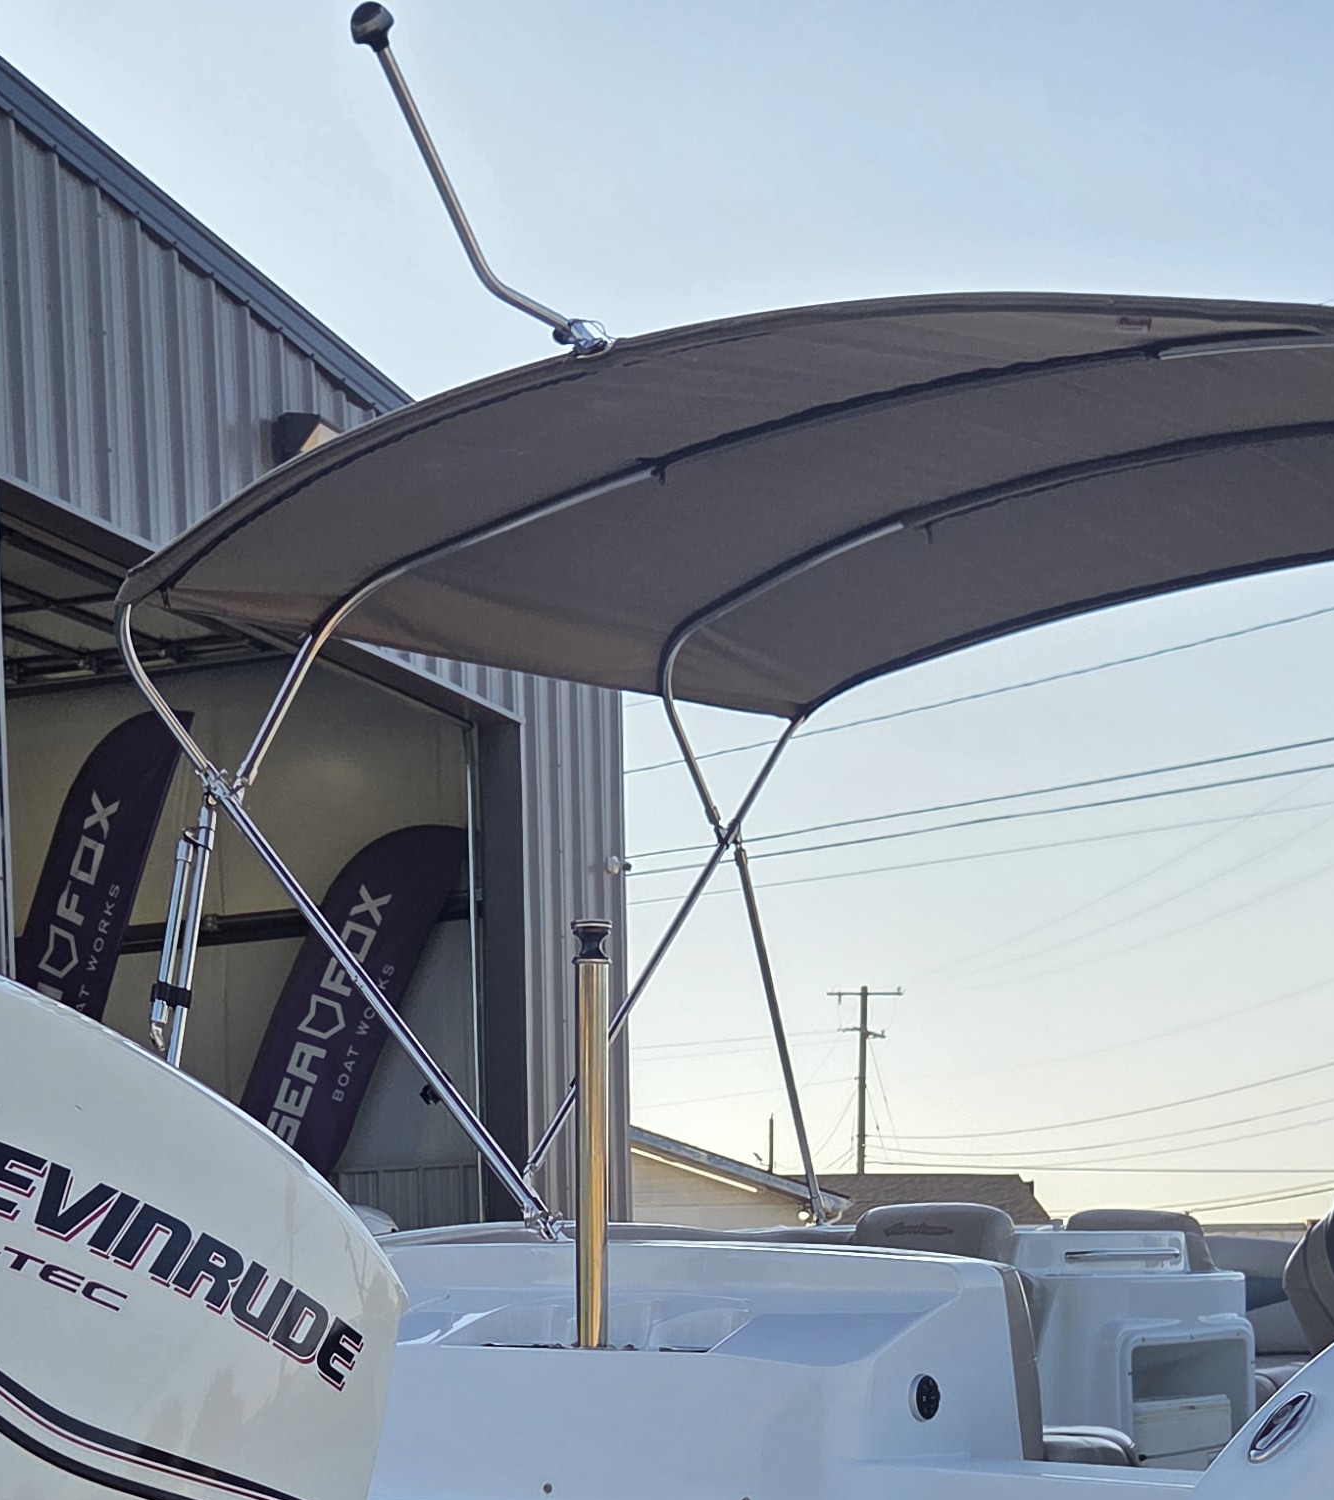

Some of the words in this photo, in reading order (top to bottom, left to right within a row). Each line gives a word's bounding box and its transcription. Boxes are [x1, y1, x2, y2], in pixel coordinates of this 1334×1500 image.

[56, 790, 120, 927] FOX
[86, 884, 120, 971] WORKS
[331, 1045, 360, 1102] BOAT
[356, 963, 396, 1036] WOKS
[267, 1041, 327, 1146] SEA
